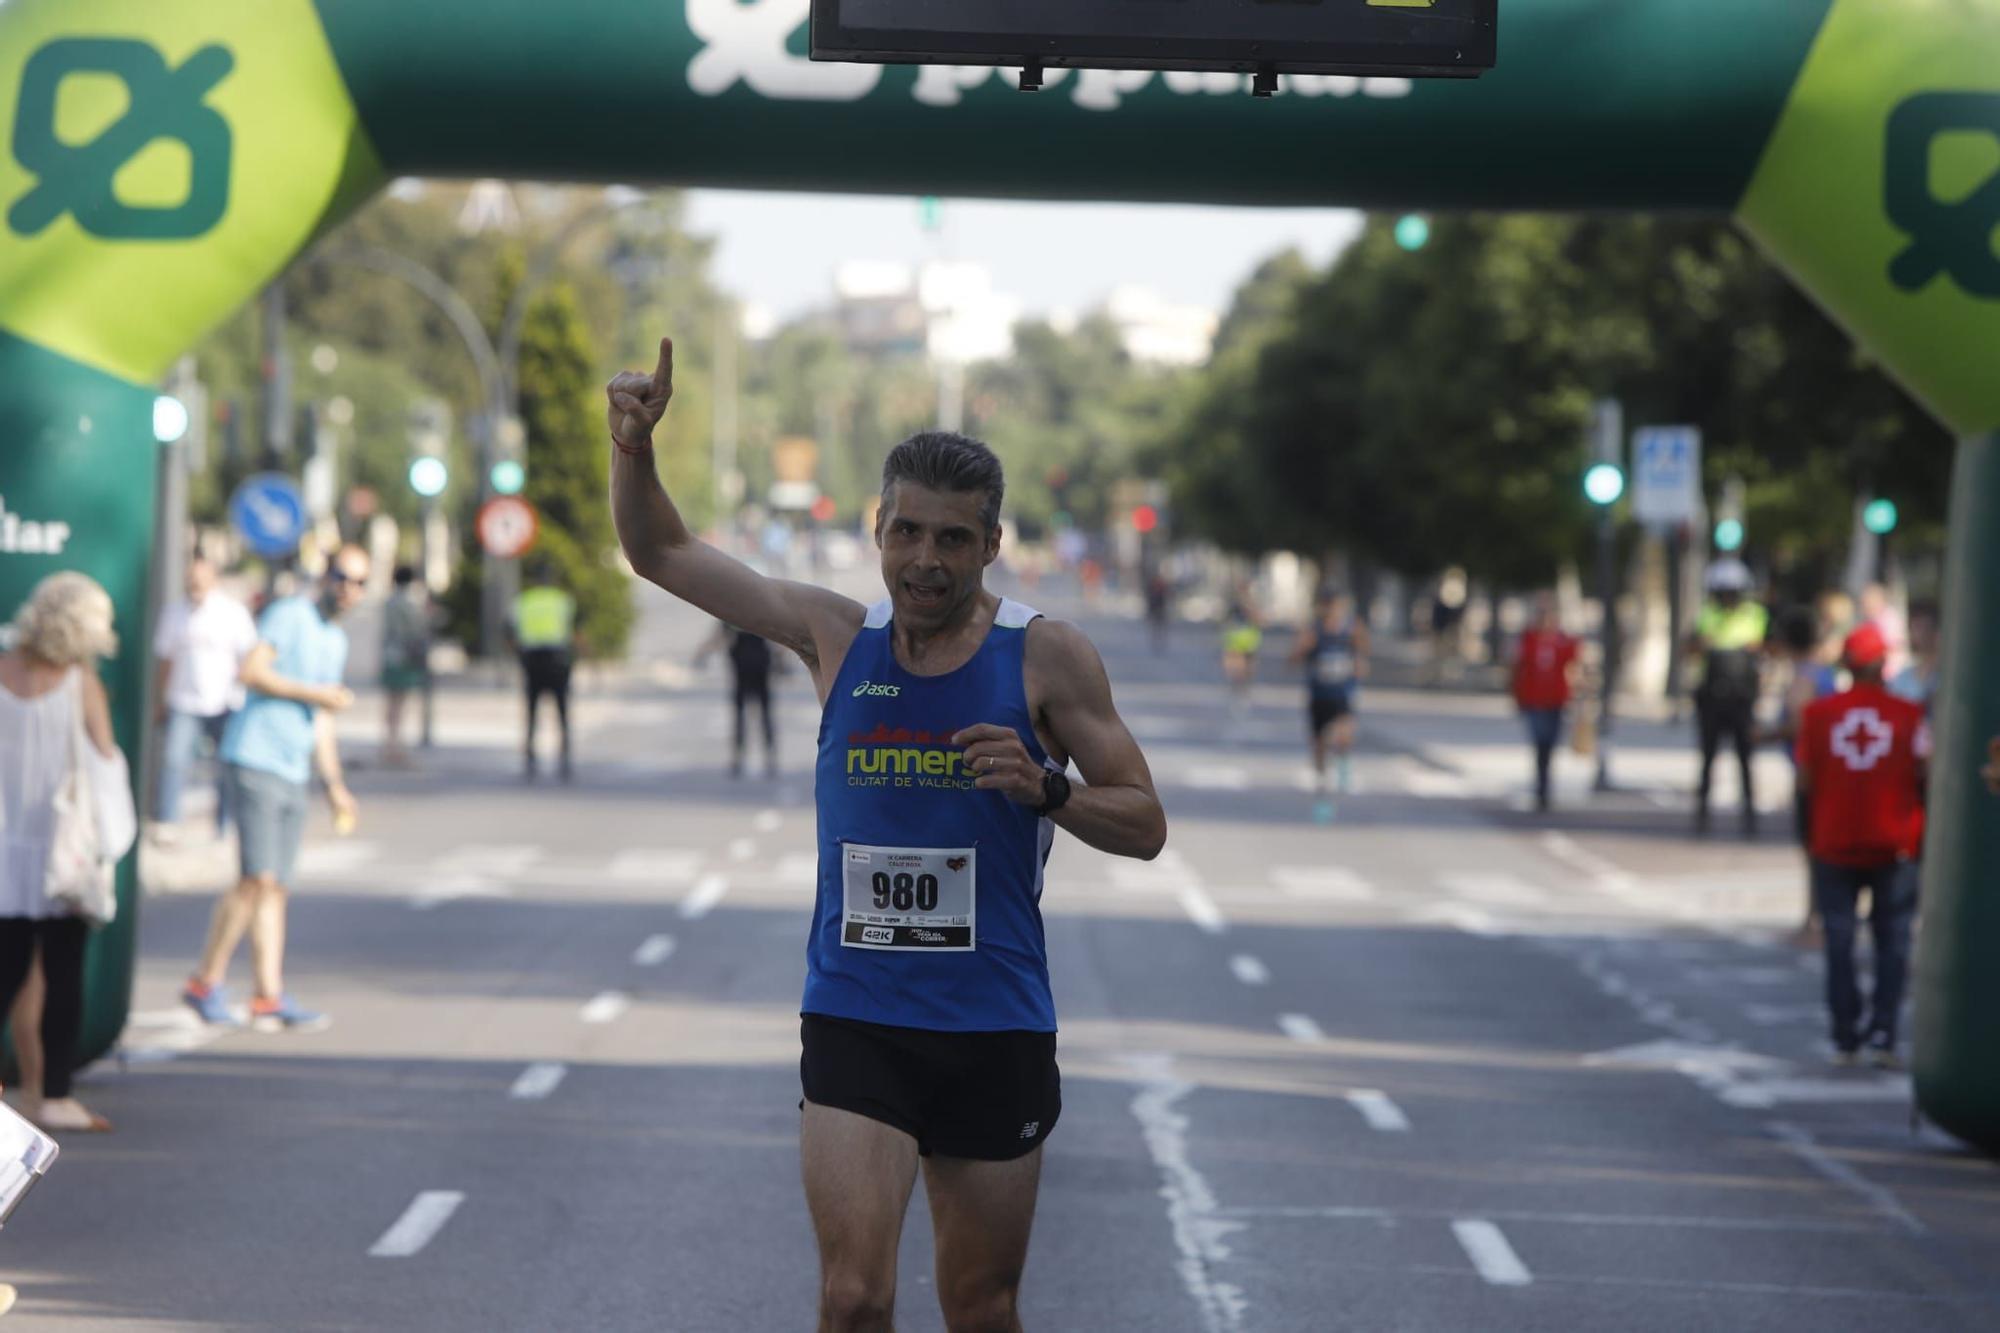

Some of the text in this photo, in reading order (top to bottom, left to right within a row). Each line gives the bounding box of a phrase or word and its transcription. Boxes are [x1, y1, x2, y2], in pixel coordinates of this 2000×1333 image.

[866, 684, 901, 697] asics
[847, 776, 889, 786] CIUTAT
[894, 776, 912, 787] DE
[872, 871, 938, 911] 980
[864, 930, 890, 940] 42K
